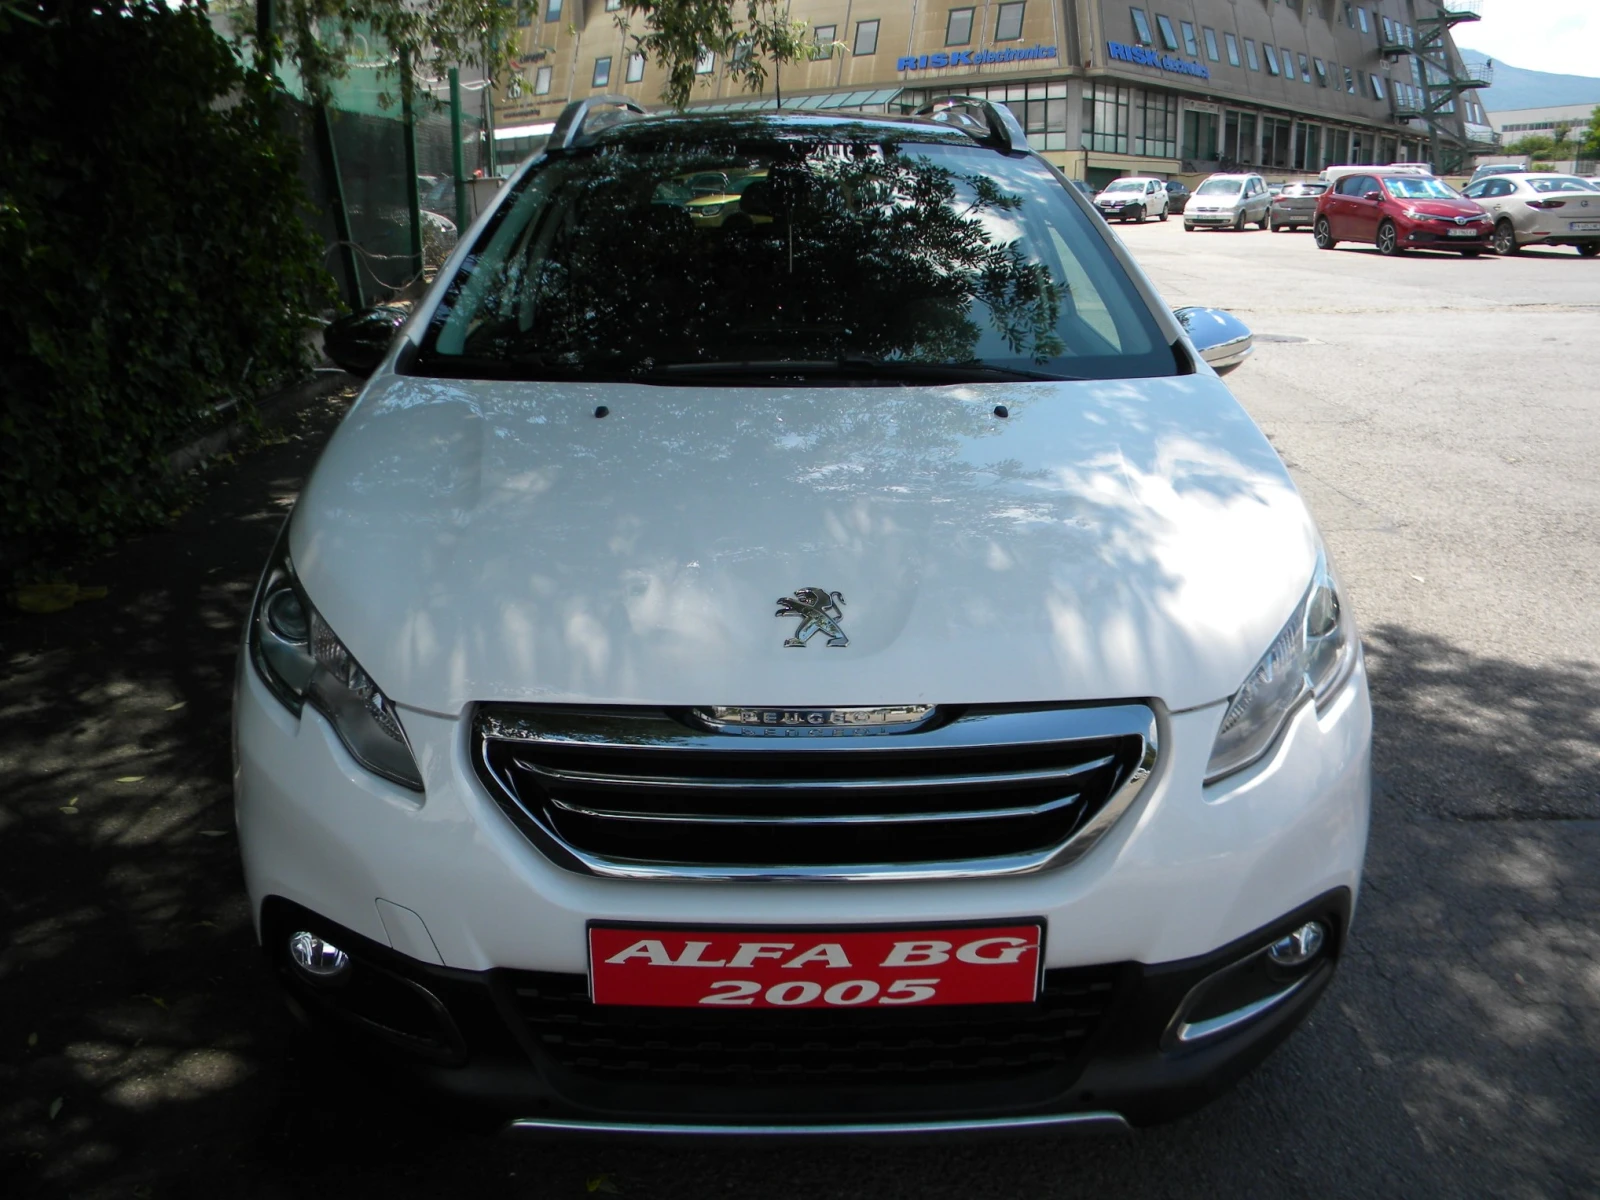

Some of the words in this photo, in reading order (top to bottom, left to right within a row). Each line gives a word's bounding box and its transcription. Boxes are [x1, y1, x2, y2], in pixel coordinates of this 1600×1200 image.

[897, 50, 973, 72] RISK
[974, 43, 1057, 65] electronics
[1107, 41, 1162, 69] RISK
[740, 709, 891, 724] PEUGEOT
[604, 938, 853, 969] ALFA
[879, 937, 1029, 967] BG
[698, 978, 941, 1006] 2005
